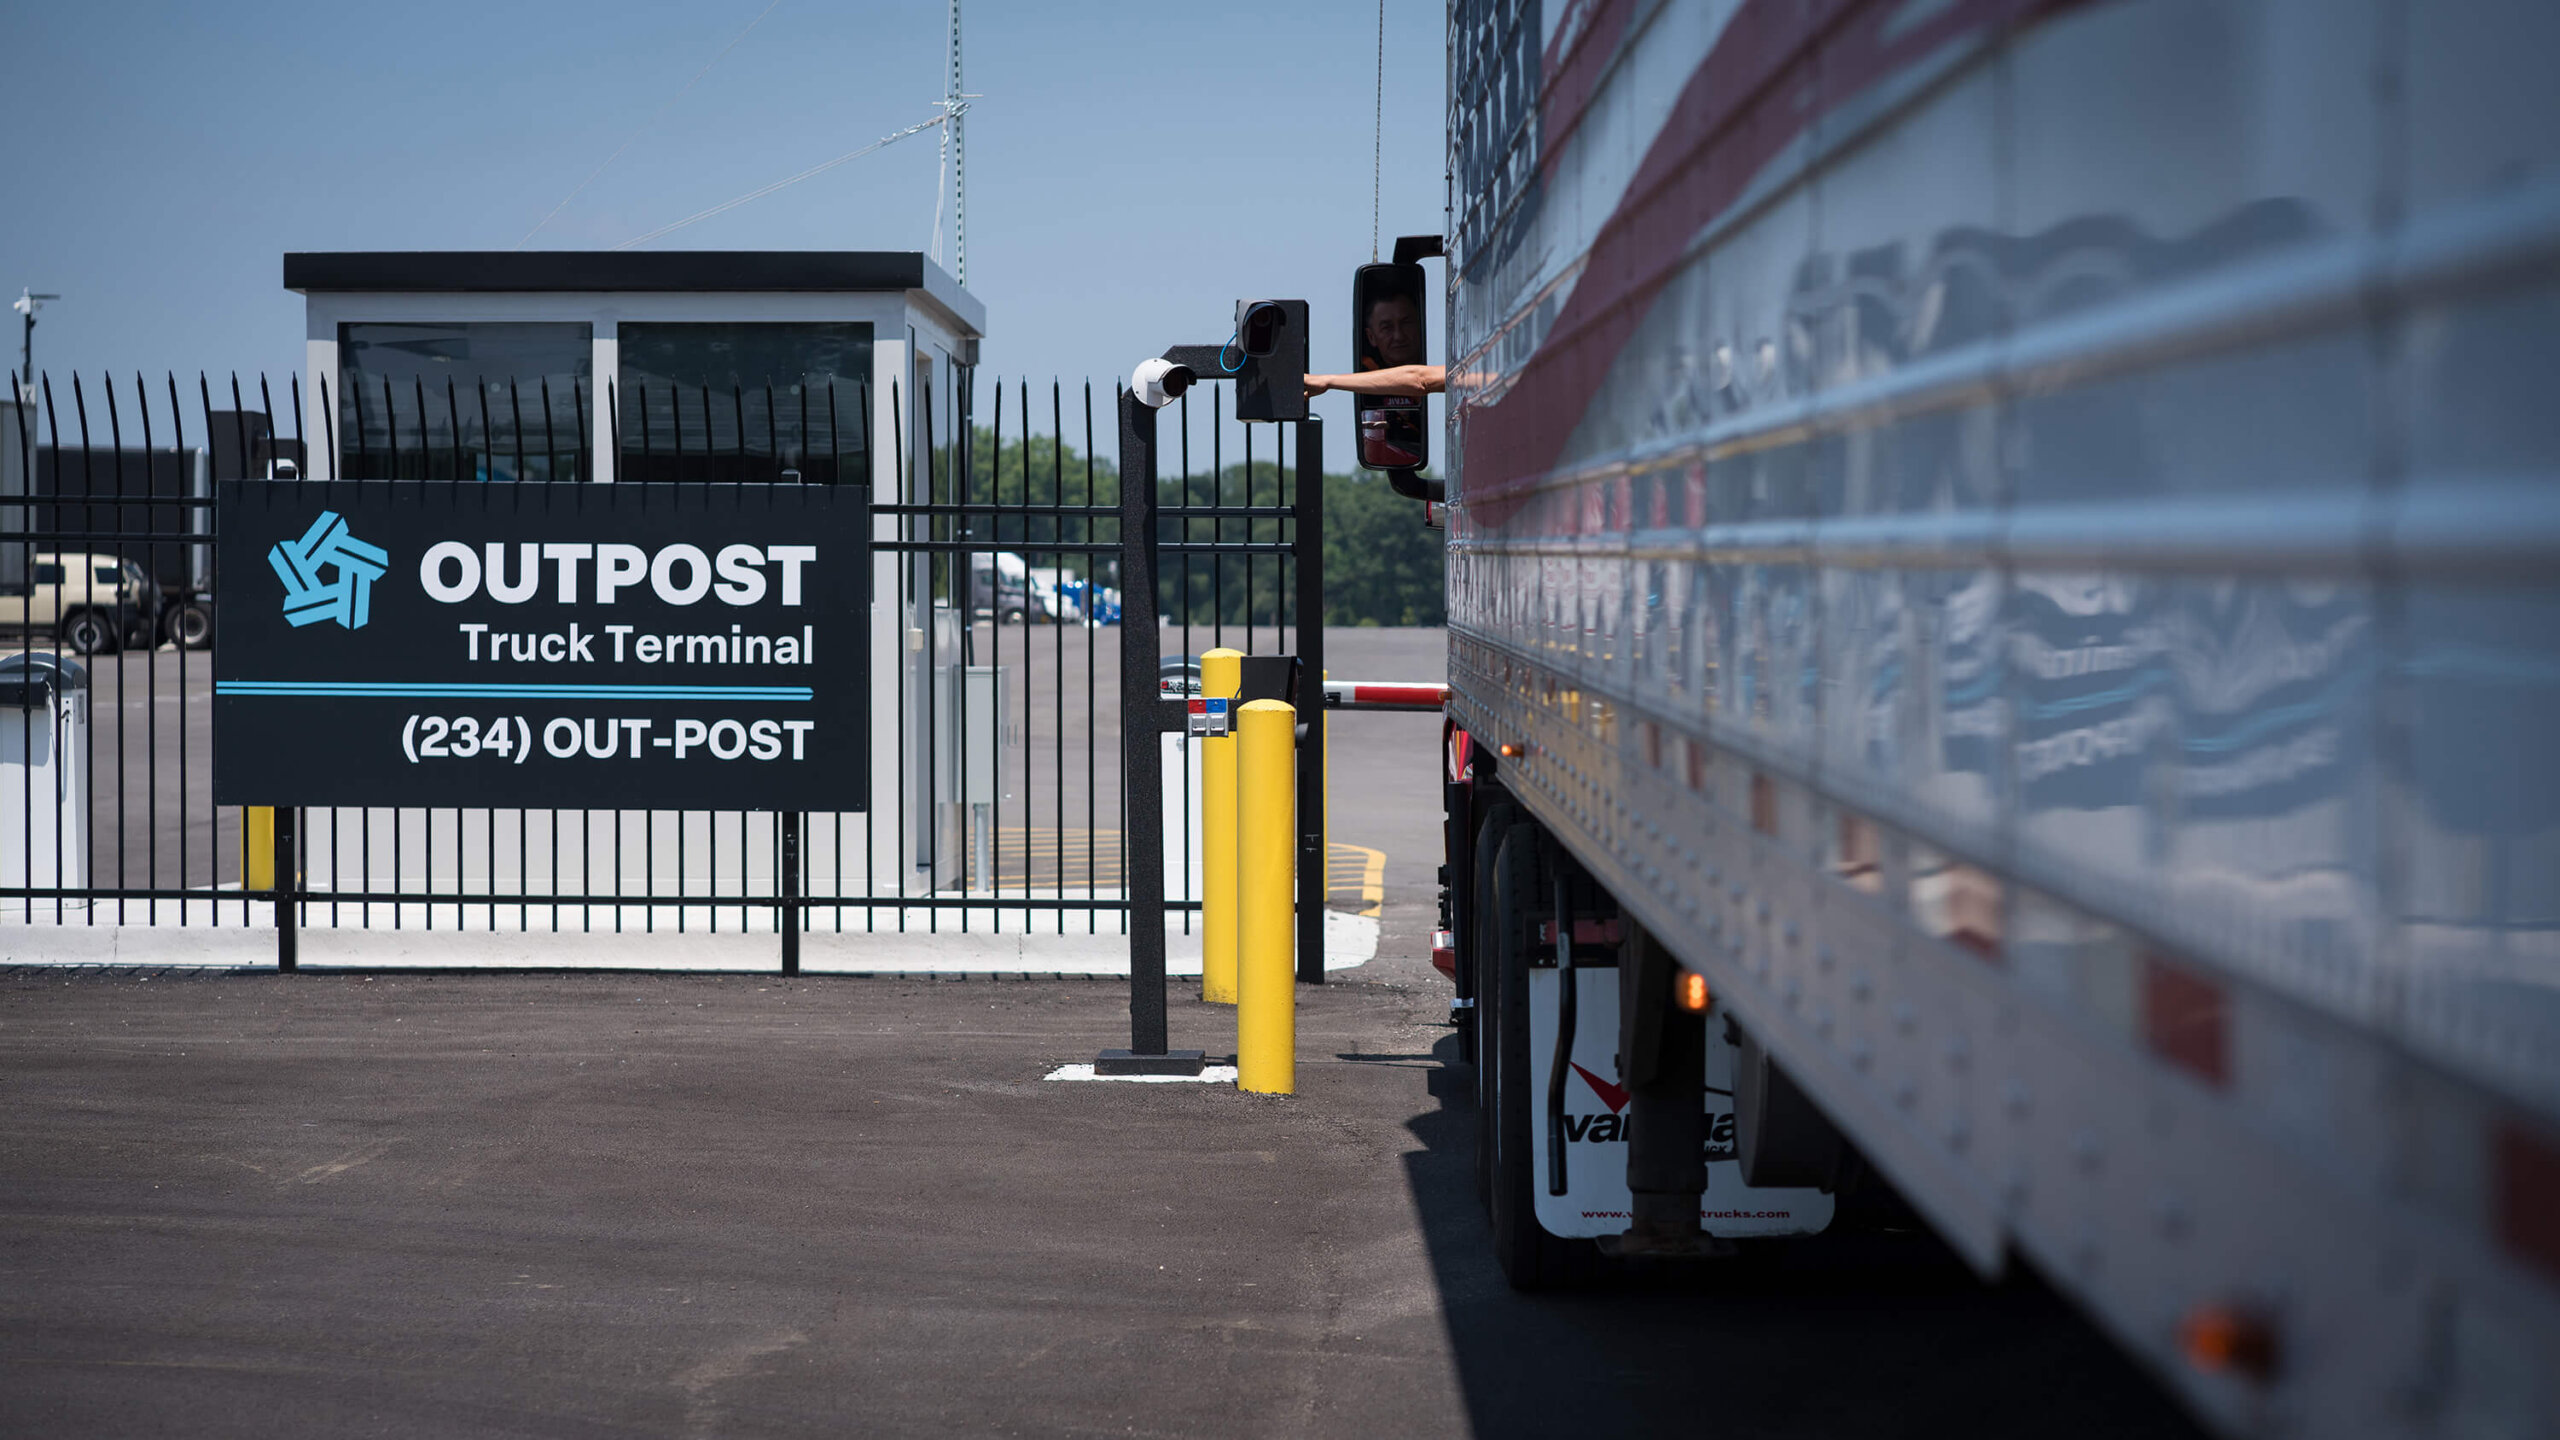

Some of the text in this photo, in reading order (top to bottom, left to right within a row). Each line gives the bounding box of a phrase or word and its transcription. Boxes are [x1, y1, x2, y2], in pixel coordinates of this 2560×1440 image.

[420, 541, 817, 606] OUTPOST
[459, 622, 813, 665] Truck Terminal
[402, 714, 815, 764] (234) OUT-POST
[1581, 1209, 1790, 1219] www.vtrucks.com
